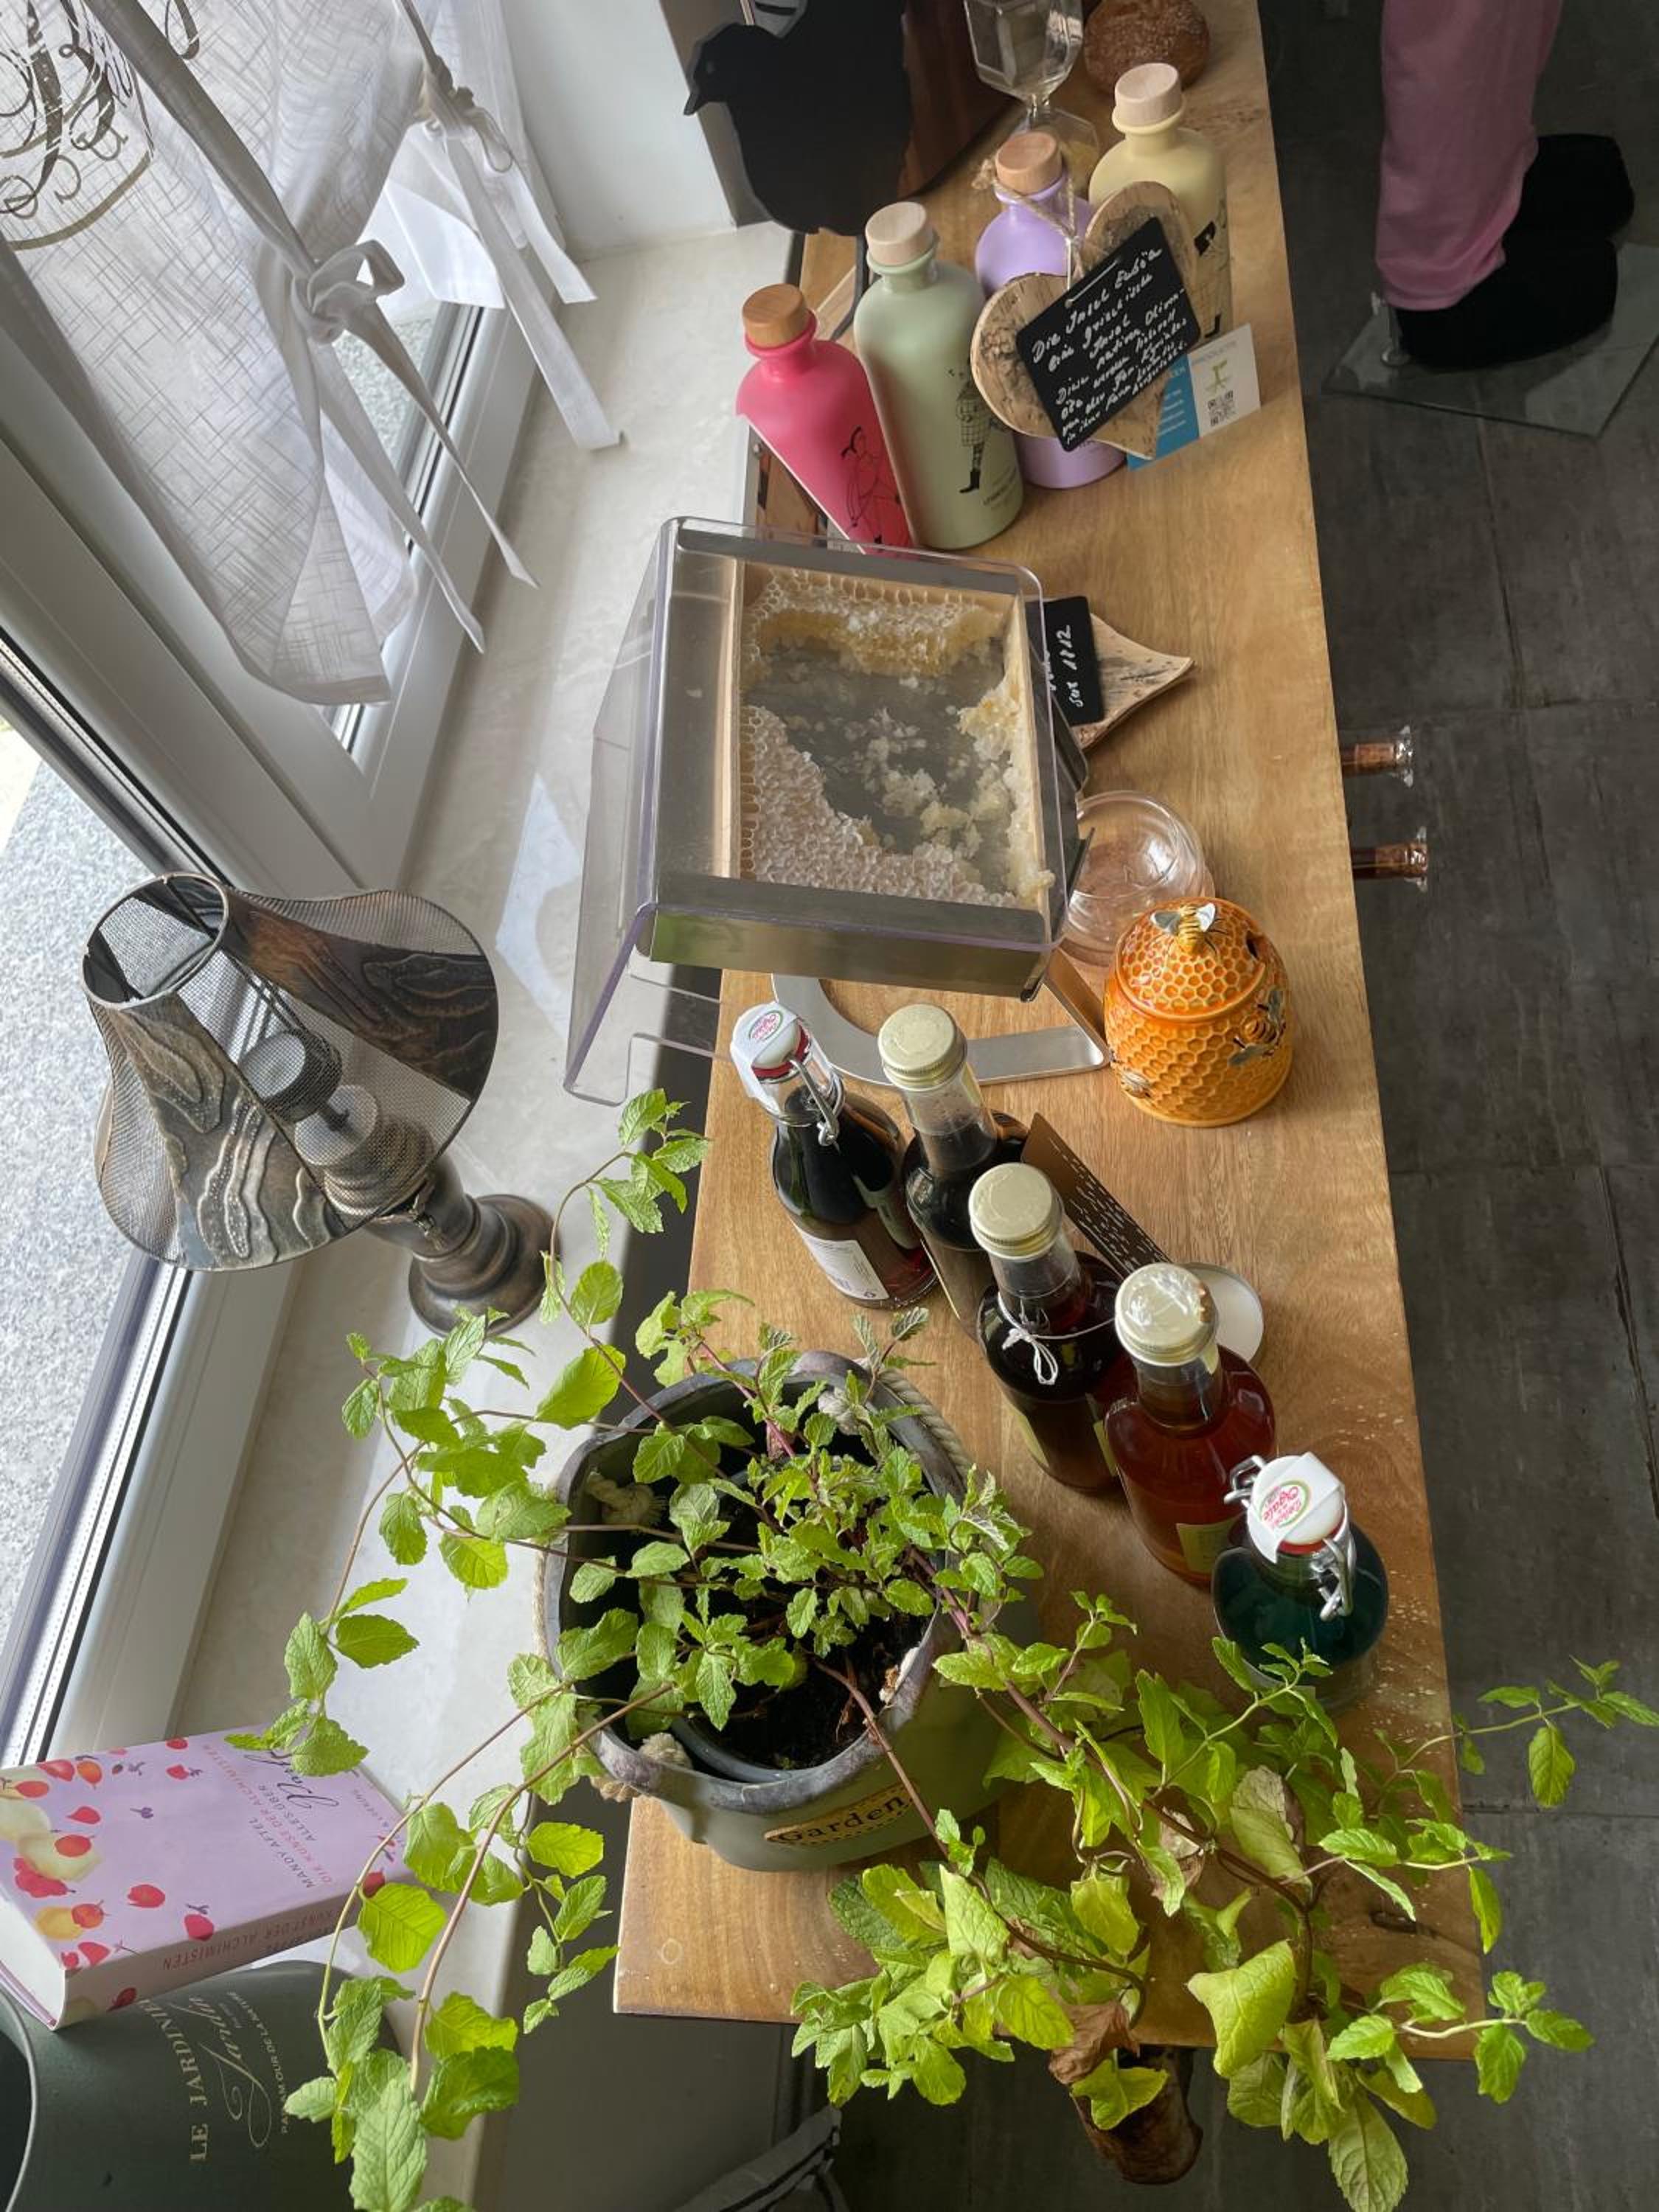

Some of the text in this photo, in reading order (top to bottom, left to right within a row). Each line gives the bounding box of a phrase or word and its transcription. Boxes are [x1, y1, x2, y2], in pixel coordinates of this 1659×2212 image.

[1032, 335, 1062, 364] Die
[1065, 288, 1109, 334] Insel
[778, 1794, 905, 1844] Garden
[279, 1850, 316, 1889] MANDY
[257, 2023, 269, 2037] LA
[263, 2038, 276, 2054] DE
[136, 1998, 209, 2161] LE JARDINIE
